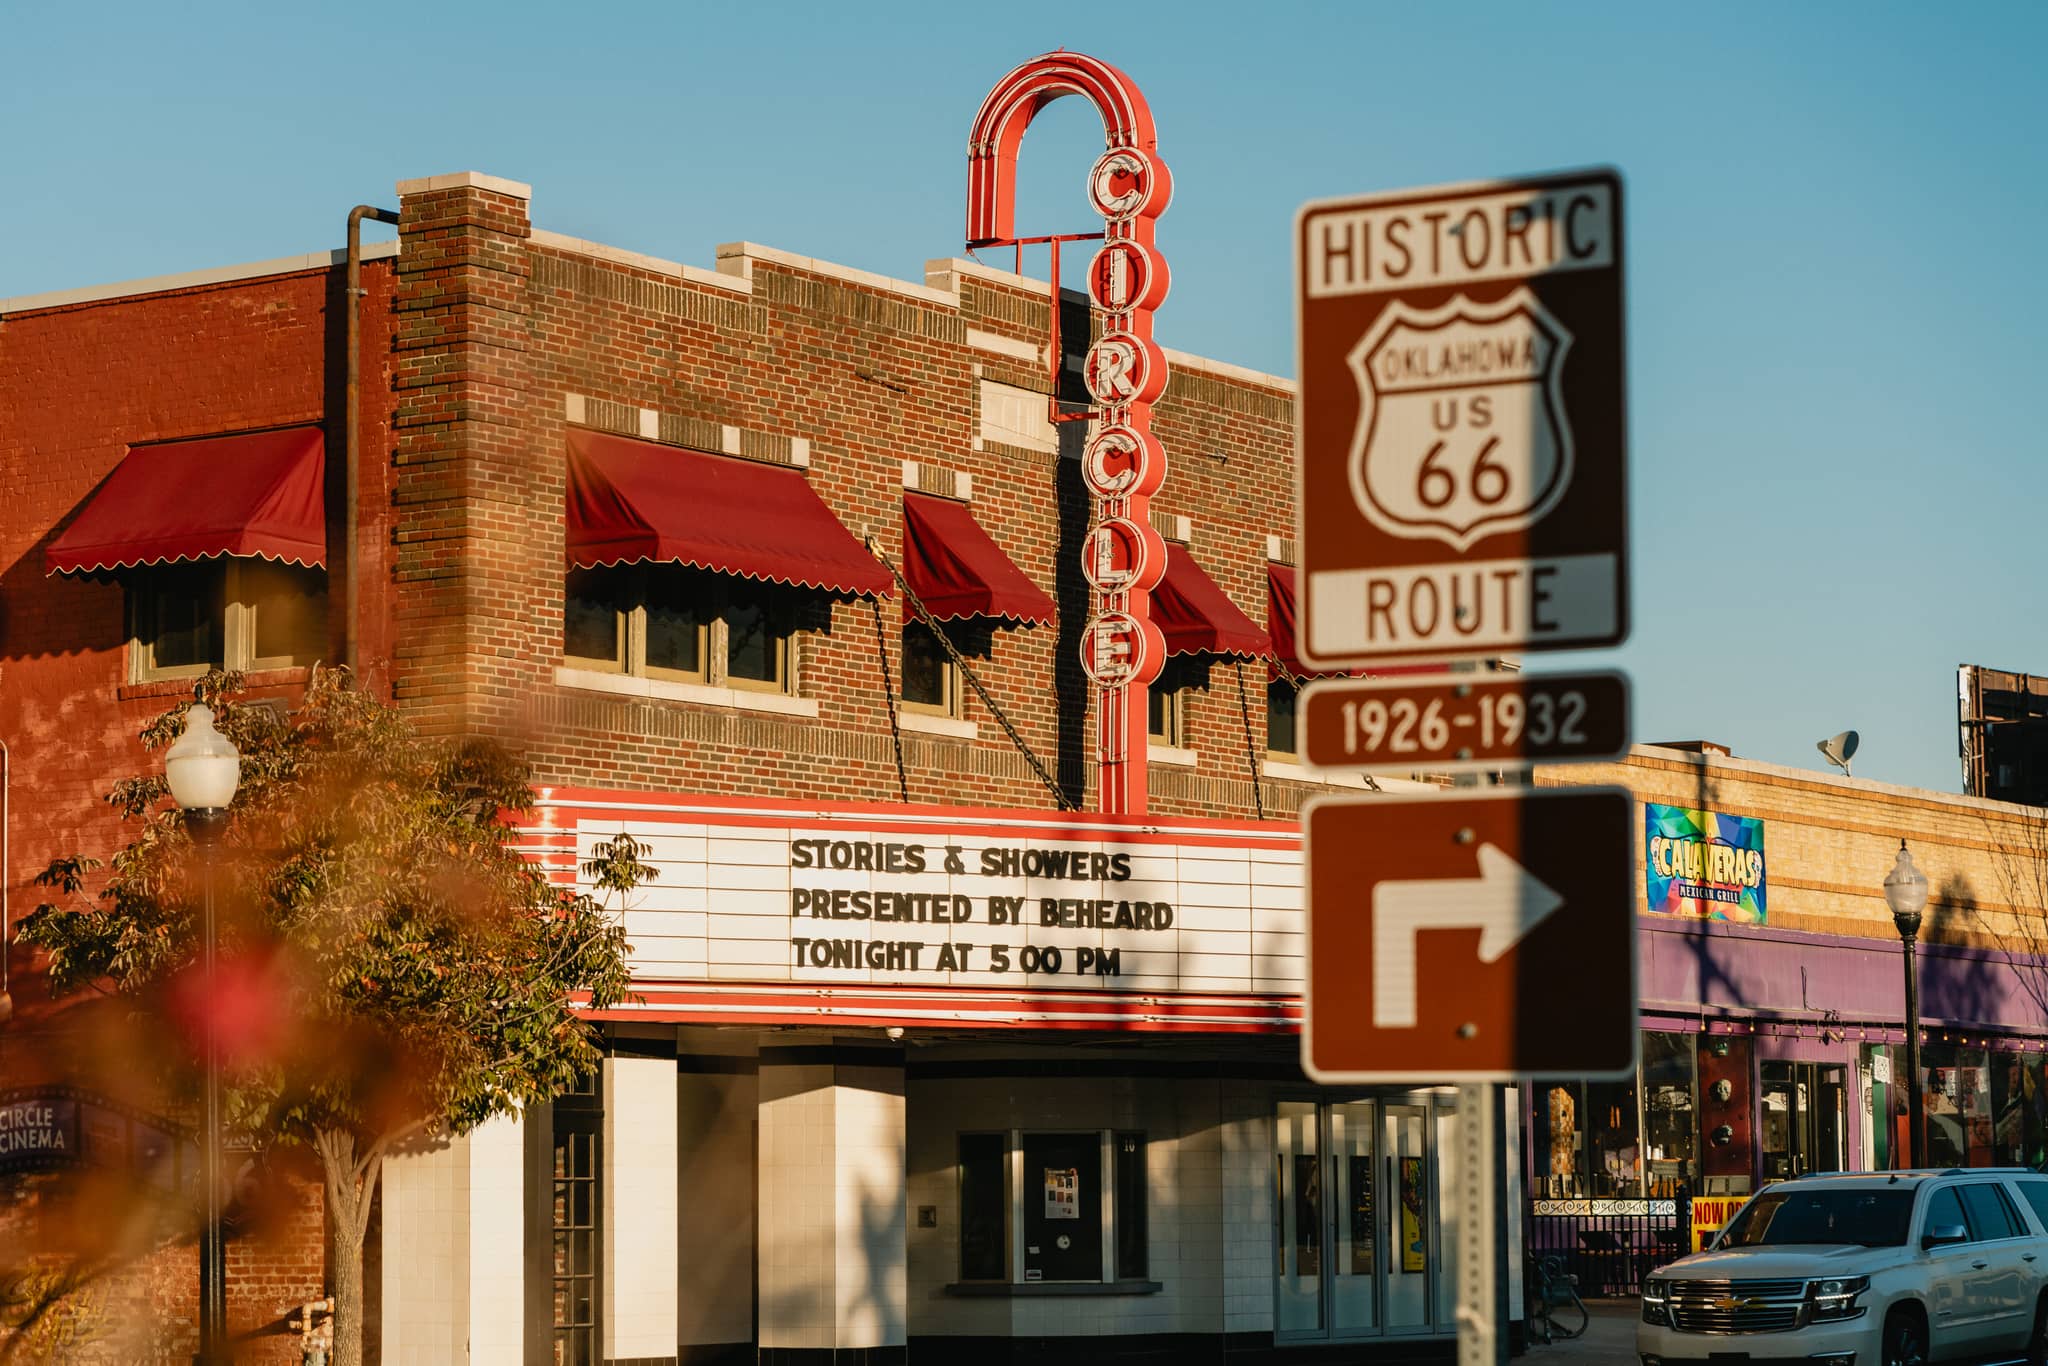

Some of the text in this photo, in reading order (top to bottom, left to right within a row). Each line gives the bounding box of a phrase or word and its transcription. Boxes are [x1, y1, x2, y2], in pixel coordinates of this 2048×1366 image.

[1322, 194, 1598, 285] HISTORIC
[1091, 153, 1145, 680] CIRCLE
[1432, 396, 1493, 432] US
[1416, 436, 1510, 510] 66
[1367, 565, 1560, 643] ROUTE
[1341, 691, 1588, 755] 1926-1932
[792, 839, 1131, 881] STORIES & SHOWERS
[1659, 837, 1754, 887] CALAVERAS
[792, 888, 1173, 930] PRESENTED BY BEHEARD
[1680, 886, 1738, 902] MEXICAN GRILL
[792, 938, 1120, 976] TONIGHT AT 5 00 PM
[0, 1107, 53, 1131] CIRCLE
[0, 1129, 65, 1153] CINEMA
[1694, 1202, 1724, 1224] NOW
